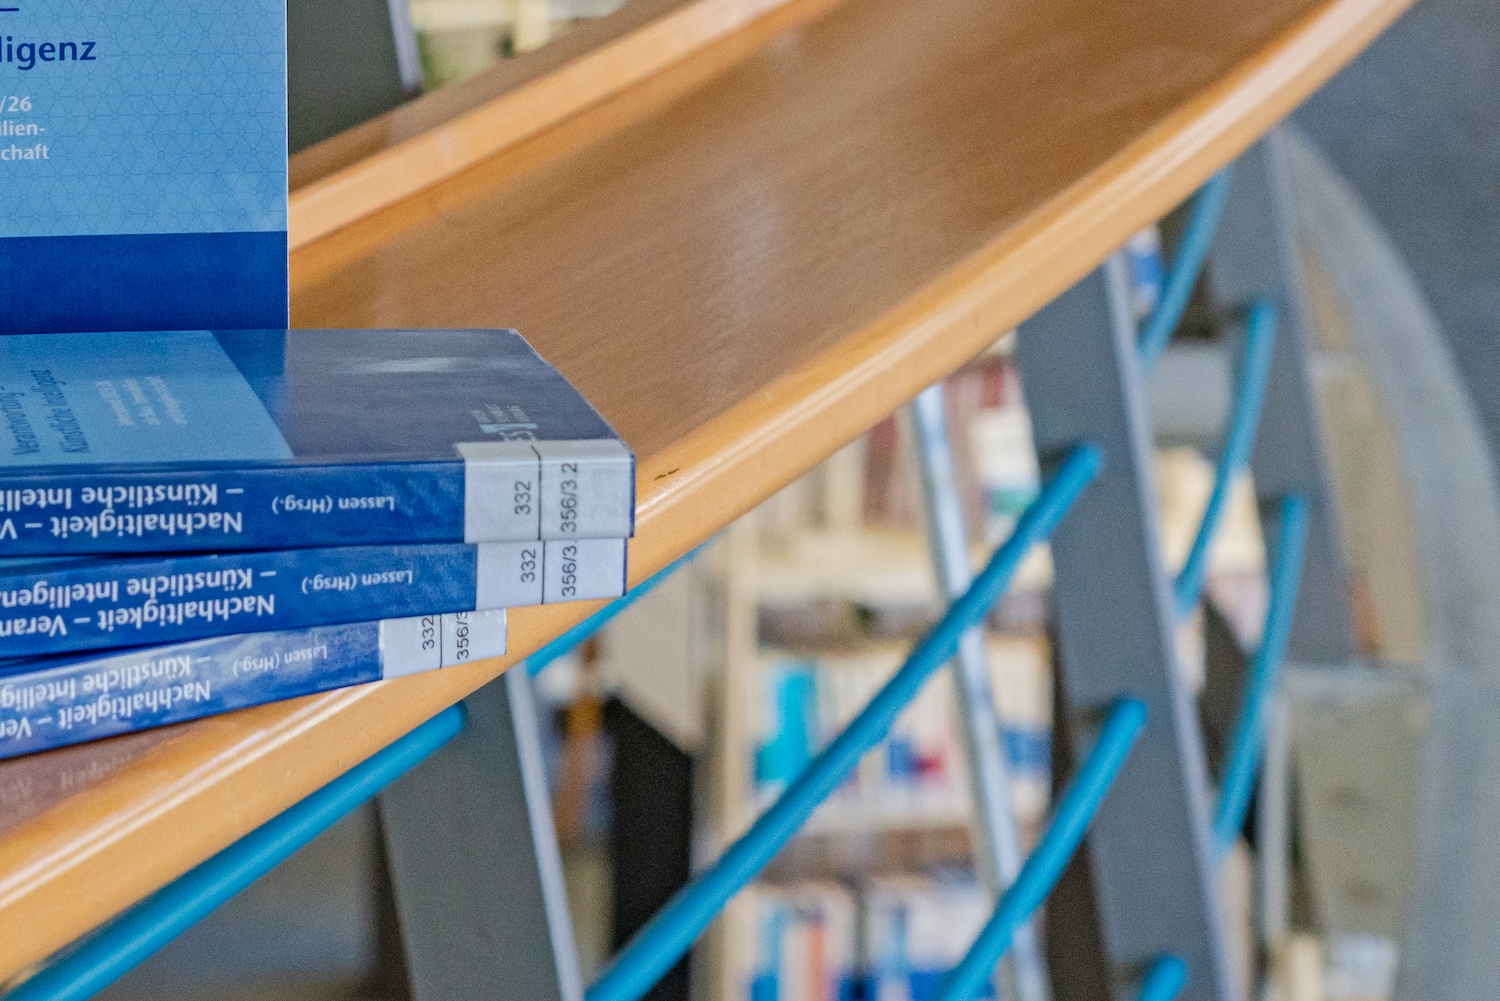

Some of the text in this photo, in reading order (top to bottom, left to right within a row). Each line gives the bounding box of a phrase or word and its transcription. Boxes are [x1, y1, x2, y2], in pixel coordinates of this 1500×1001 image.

[82, 484, 218, 506] Künstliche
[271, 495, 395, 514] Lassen (Hrsg.)
[513, 480, 532, 515] 332
[560, 463, 578, 533] 356/3.2
[50, 511, 243, 539] Nachhaltigkeit
[126, 568, 252, 596] Künstliche
[302, 569, 413, 595] Lassen (Hrsg.)
[520, 548, 537, 583] 332
[98, 594, 275, 629] Nachhaltigkeit
[422, 615, 435, 651] 332
[83, 655, 191, 692] Künstliche
[233, 644, 328, 678] Lassen (Hrsg.)
[58, 680, 211, 730] Nachhaltigkeit
